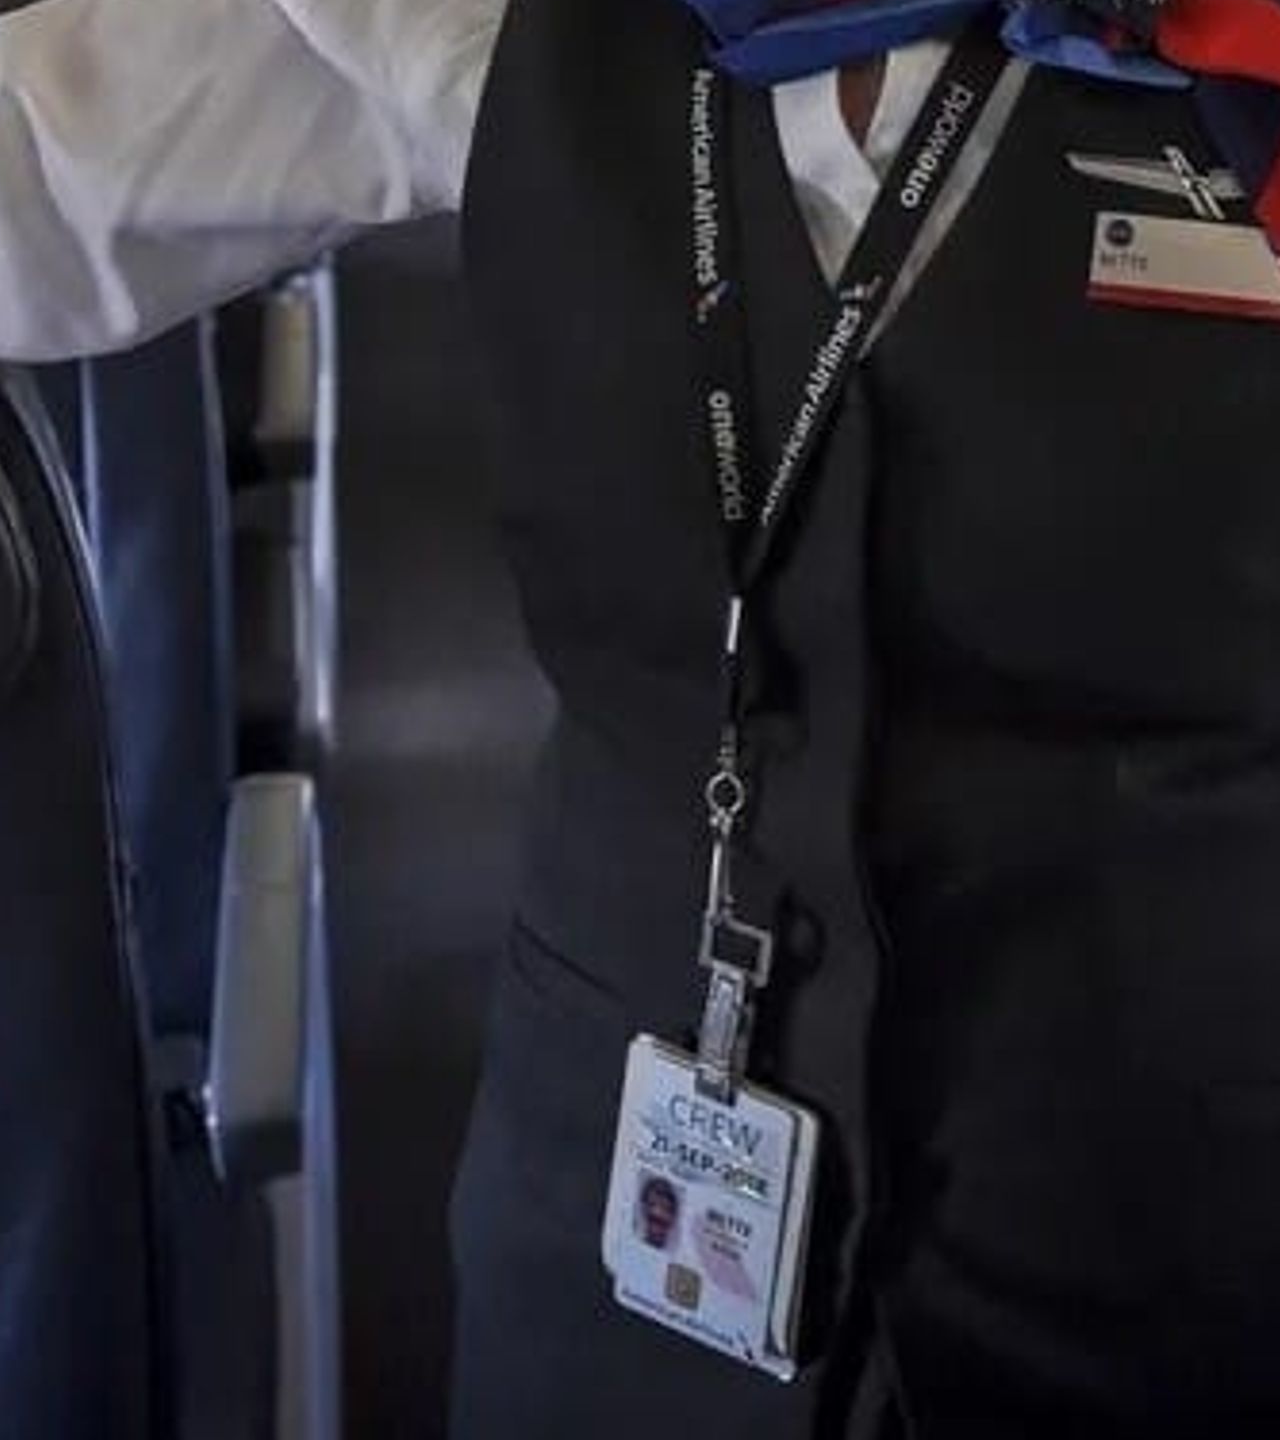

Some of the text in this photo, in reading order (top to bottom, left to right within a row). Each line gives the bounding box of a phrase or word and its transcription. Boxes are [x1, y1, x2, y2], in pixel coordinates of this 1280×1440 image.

[691, 68, 719, 285] American Airlines
[900, 82, 975, 208] oneworld
[805, 306, 861, 404] Airlines
[708, 391, 744, 520] oneworld
[670, 1095, 764, 1156] CREW
